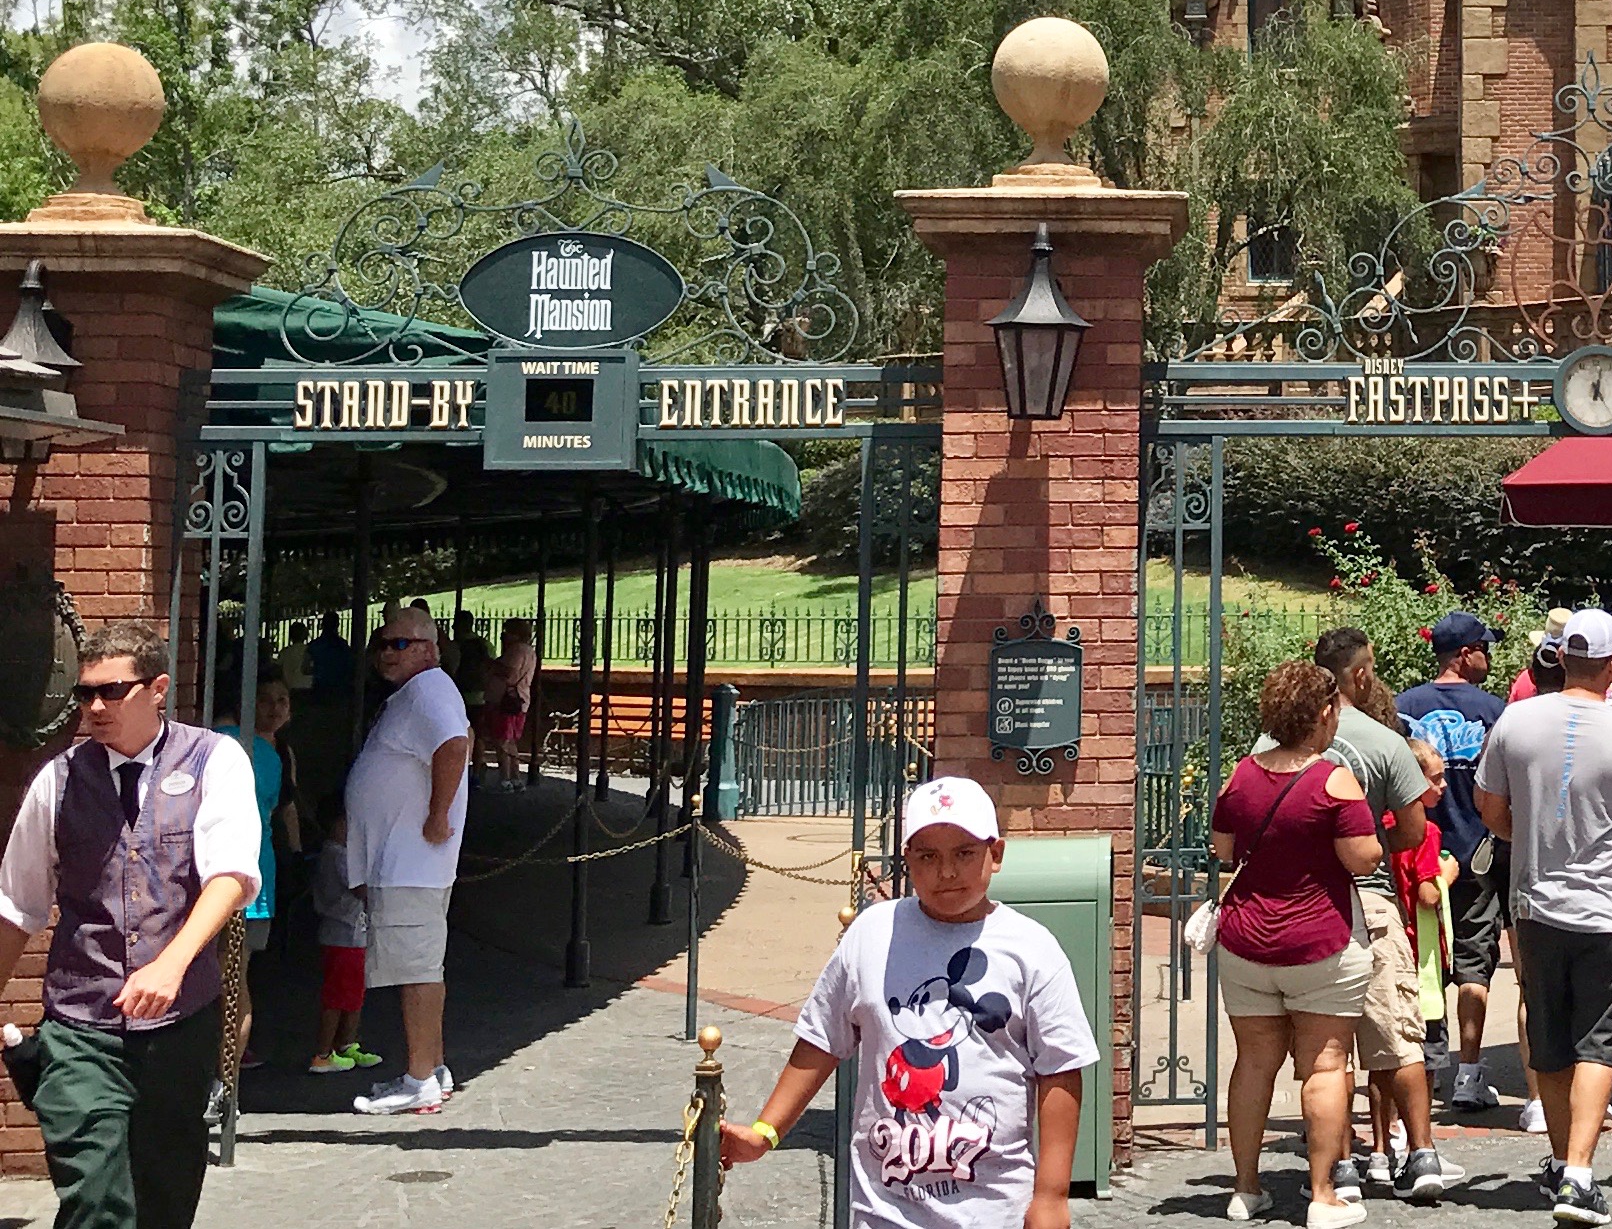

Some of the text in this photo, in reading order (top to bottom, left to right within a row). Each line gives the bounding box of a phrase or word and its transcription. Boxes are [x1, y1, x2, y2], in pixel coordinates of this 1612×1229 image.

[557, 239, 584, 257] The
[530, 248, 615, 290] Haunted
[524, 291, 613, 340] Mansion
[521, 361, 600, 375] WAIT TIME
[1364, 358, 1406, 375] DISNEY
[295, 380, 475, 429] STAND-BY
[544, 391, 577, 414] 40
[659, 378, 844, 428] ENTRANCE
[1347, 376, 1539, 422] FASTPASS+
[522, 435, 592, 449] MINUTES
[870, 1114, 992, 1188] 2017
[903, 1179, 961, 1202] FLORIDA
